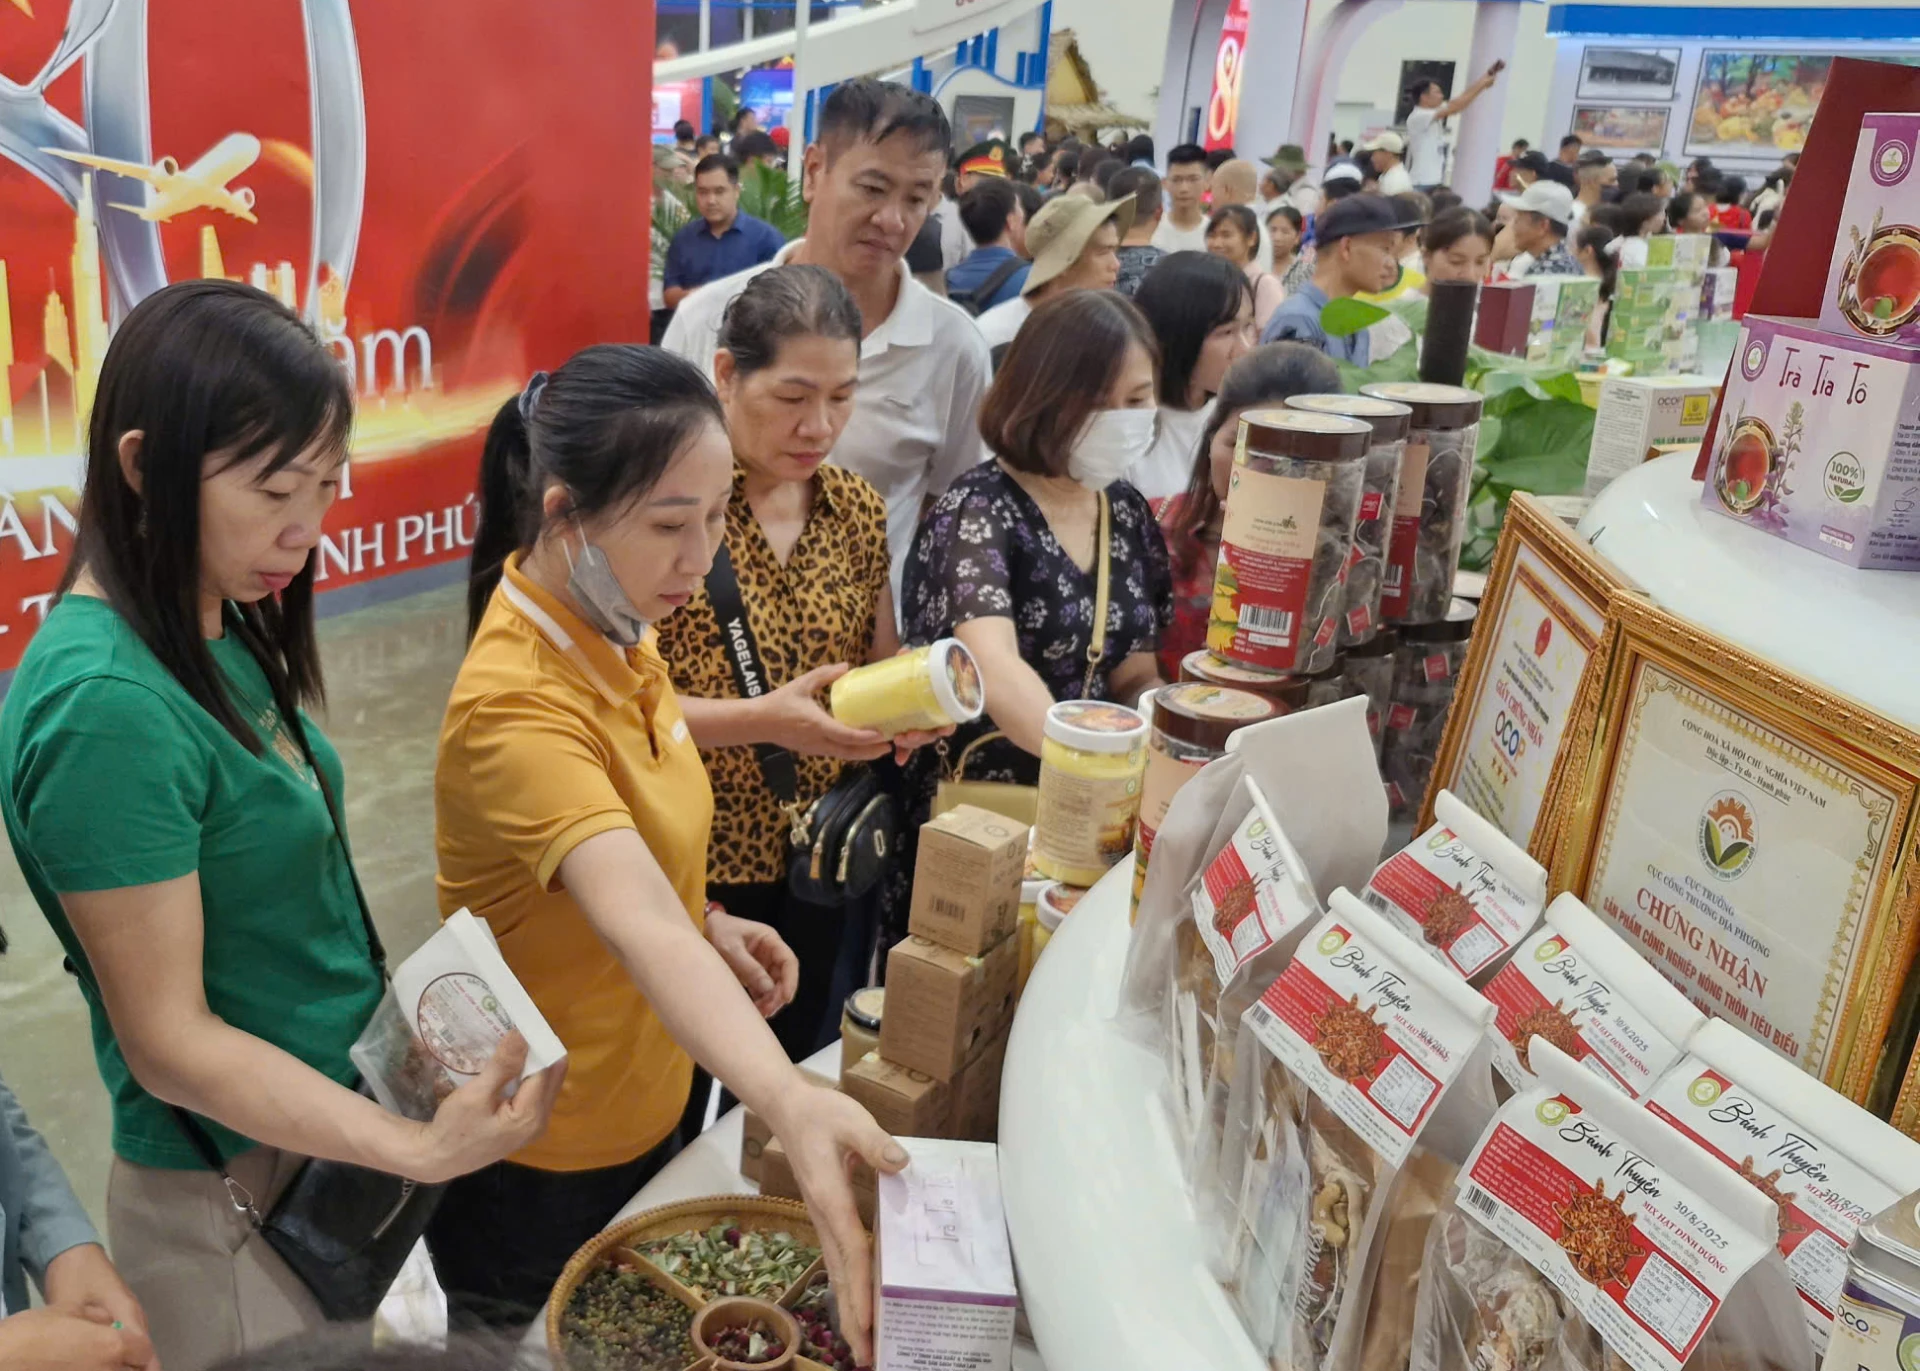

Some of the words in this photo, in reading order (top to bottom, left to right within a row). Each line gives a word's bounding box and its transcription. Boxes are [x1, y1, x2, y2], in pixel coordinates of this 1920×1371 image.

[320, 318, 433, 396] ăm
[1778, 346, 1801, 389] Trà
[1812, 354, 1835, 397] Tía
[1846, 362, 1870, 405] Tô
[1829, 473, 1856, 488] NATURAL
[1831, 461, 1859, 481] 100%
[315, 523, 384, 581] NH
[396, 492, 481, 562] PHÚ
[1495, 711, 1525, 761] OCOP
[1809, 791, 1827, 808] NAM
[1433, 843, 1474, 869] Bánh
[1684, 875, 1701, 891] CỤC
[1647, 863, 1662, 880] CỤC
[1663, 875, 1684, 896] CÔNG
[1686, 891, 1718, 921] THƯƠNG
[1718, 915, 1733, 933] ĐỊA
[1734, 926, 1770, 958] PHƯƠNG
[1636, 887, 1704, 951] CHỨNG
[1705, 937, 1768, 999] NHẬN
[1330, 946, 1378, 979] Bánh
[1368, 971, 1413, 1014] Thuyền
[1543, 954, 1587, 987] Bánh
[1574, 981, 1611, 1016] Thuyền
[1603, 897, 1619, 919] SẢN
[1618, 910, 1642, 938] PHẨM
[1642, 929, 1665, 956] CÔNG
[1665, 947, 1697, 979] NGHIỆP
[1697, 972, 1723, 1001] NÔNG
[1724, 991, 1748, 1021] THÔN
[1749, 1011, 1772, 1038] TIÊU
[1772, 1028, 1799, 1057] BIỂU
[1559, 1115, 1617, 1158] Bánh
[1614, 1151, 1662, 1199] Thuyền
[1673, 1200, 1729, 1249] 30/8/2025
[1709, 1097, 1776, 1140] Bánh
[1767, 1133, 1829, 1183] Thuyền
[1823, 1188, 1872, 1220] 30/8/20
[1643, 1200, 1660, 1217] MIX
[1657, 1214, 1676, 1232] HẠT
[1674, 1228, 1700, 1248] DINH
[1698, 1246, 1728, 1274] DƯỠNG
[1844, 1206, 1863, 1226] DIN
[1837, 1304, 1881, 1337] OCOP
